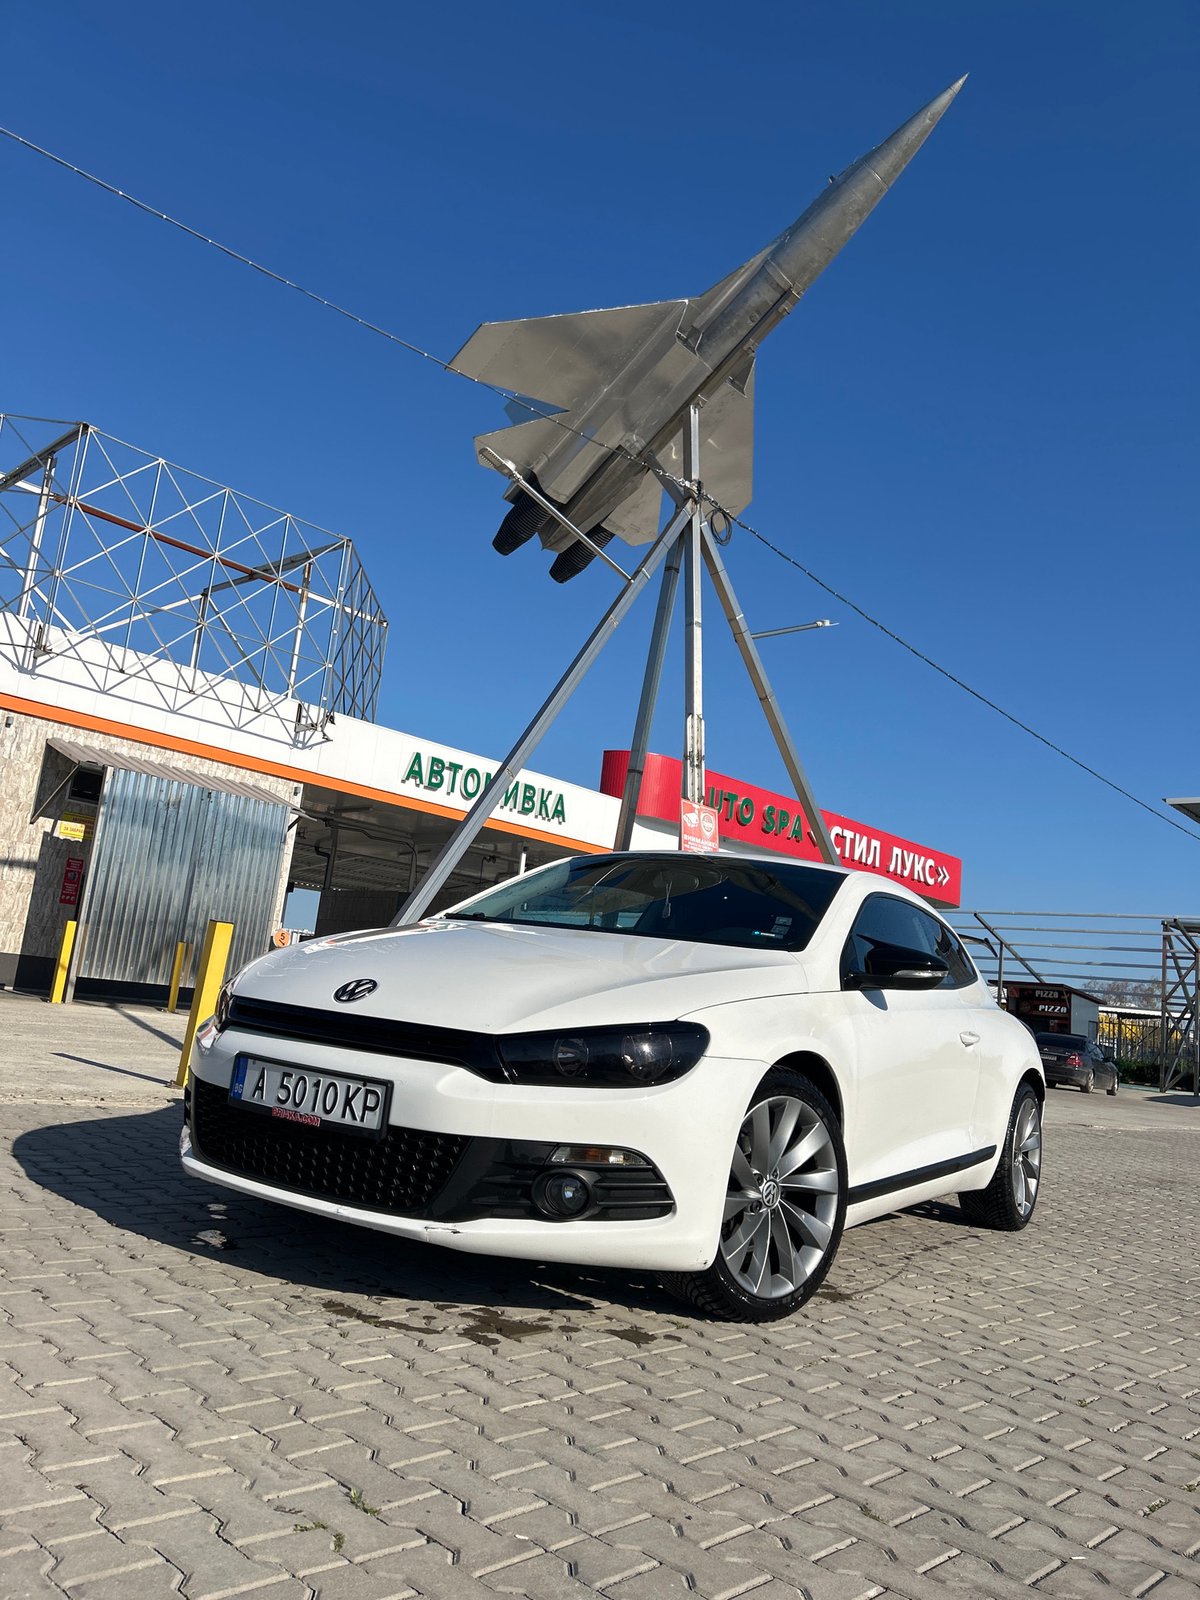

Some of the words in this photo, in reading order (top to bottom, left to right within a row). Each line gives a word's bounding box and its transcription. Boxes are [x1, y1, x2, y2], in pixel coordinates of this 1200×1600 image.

[706, 787, 754, 826] UTO
[762, 805, 803, 843] SPA
[1035, 990, 1059, 999] PIZZA
[1038, 1004, 1067, 1014] PIZZA
[252, 1067, 267, 1101] A
